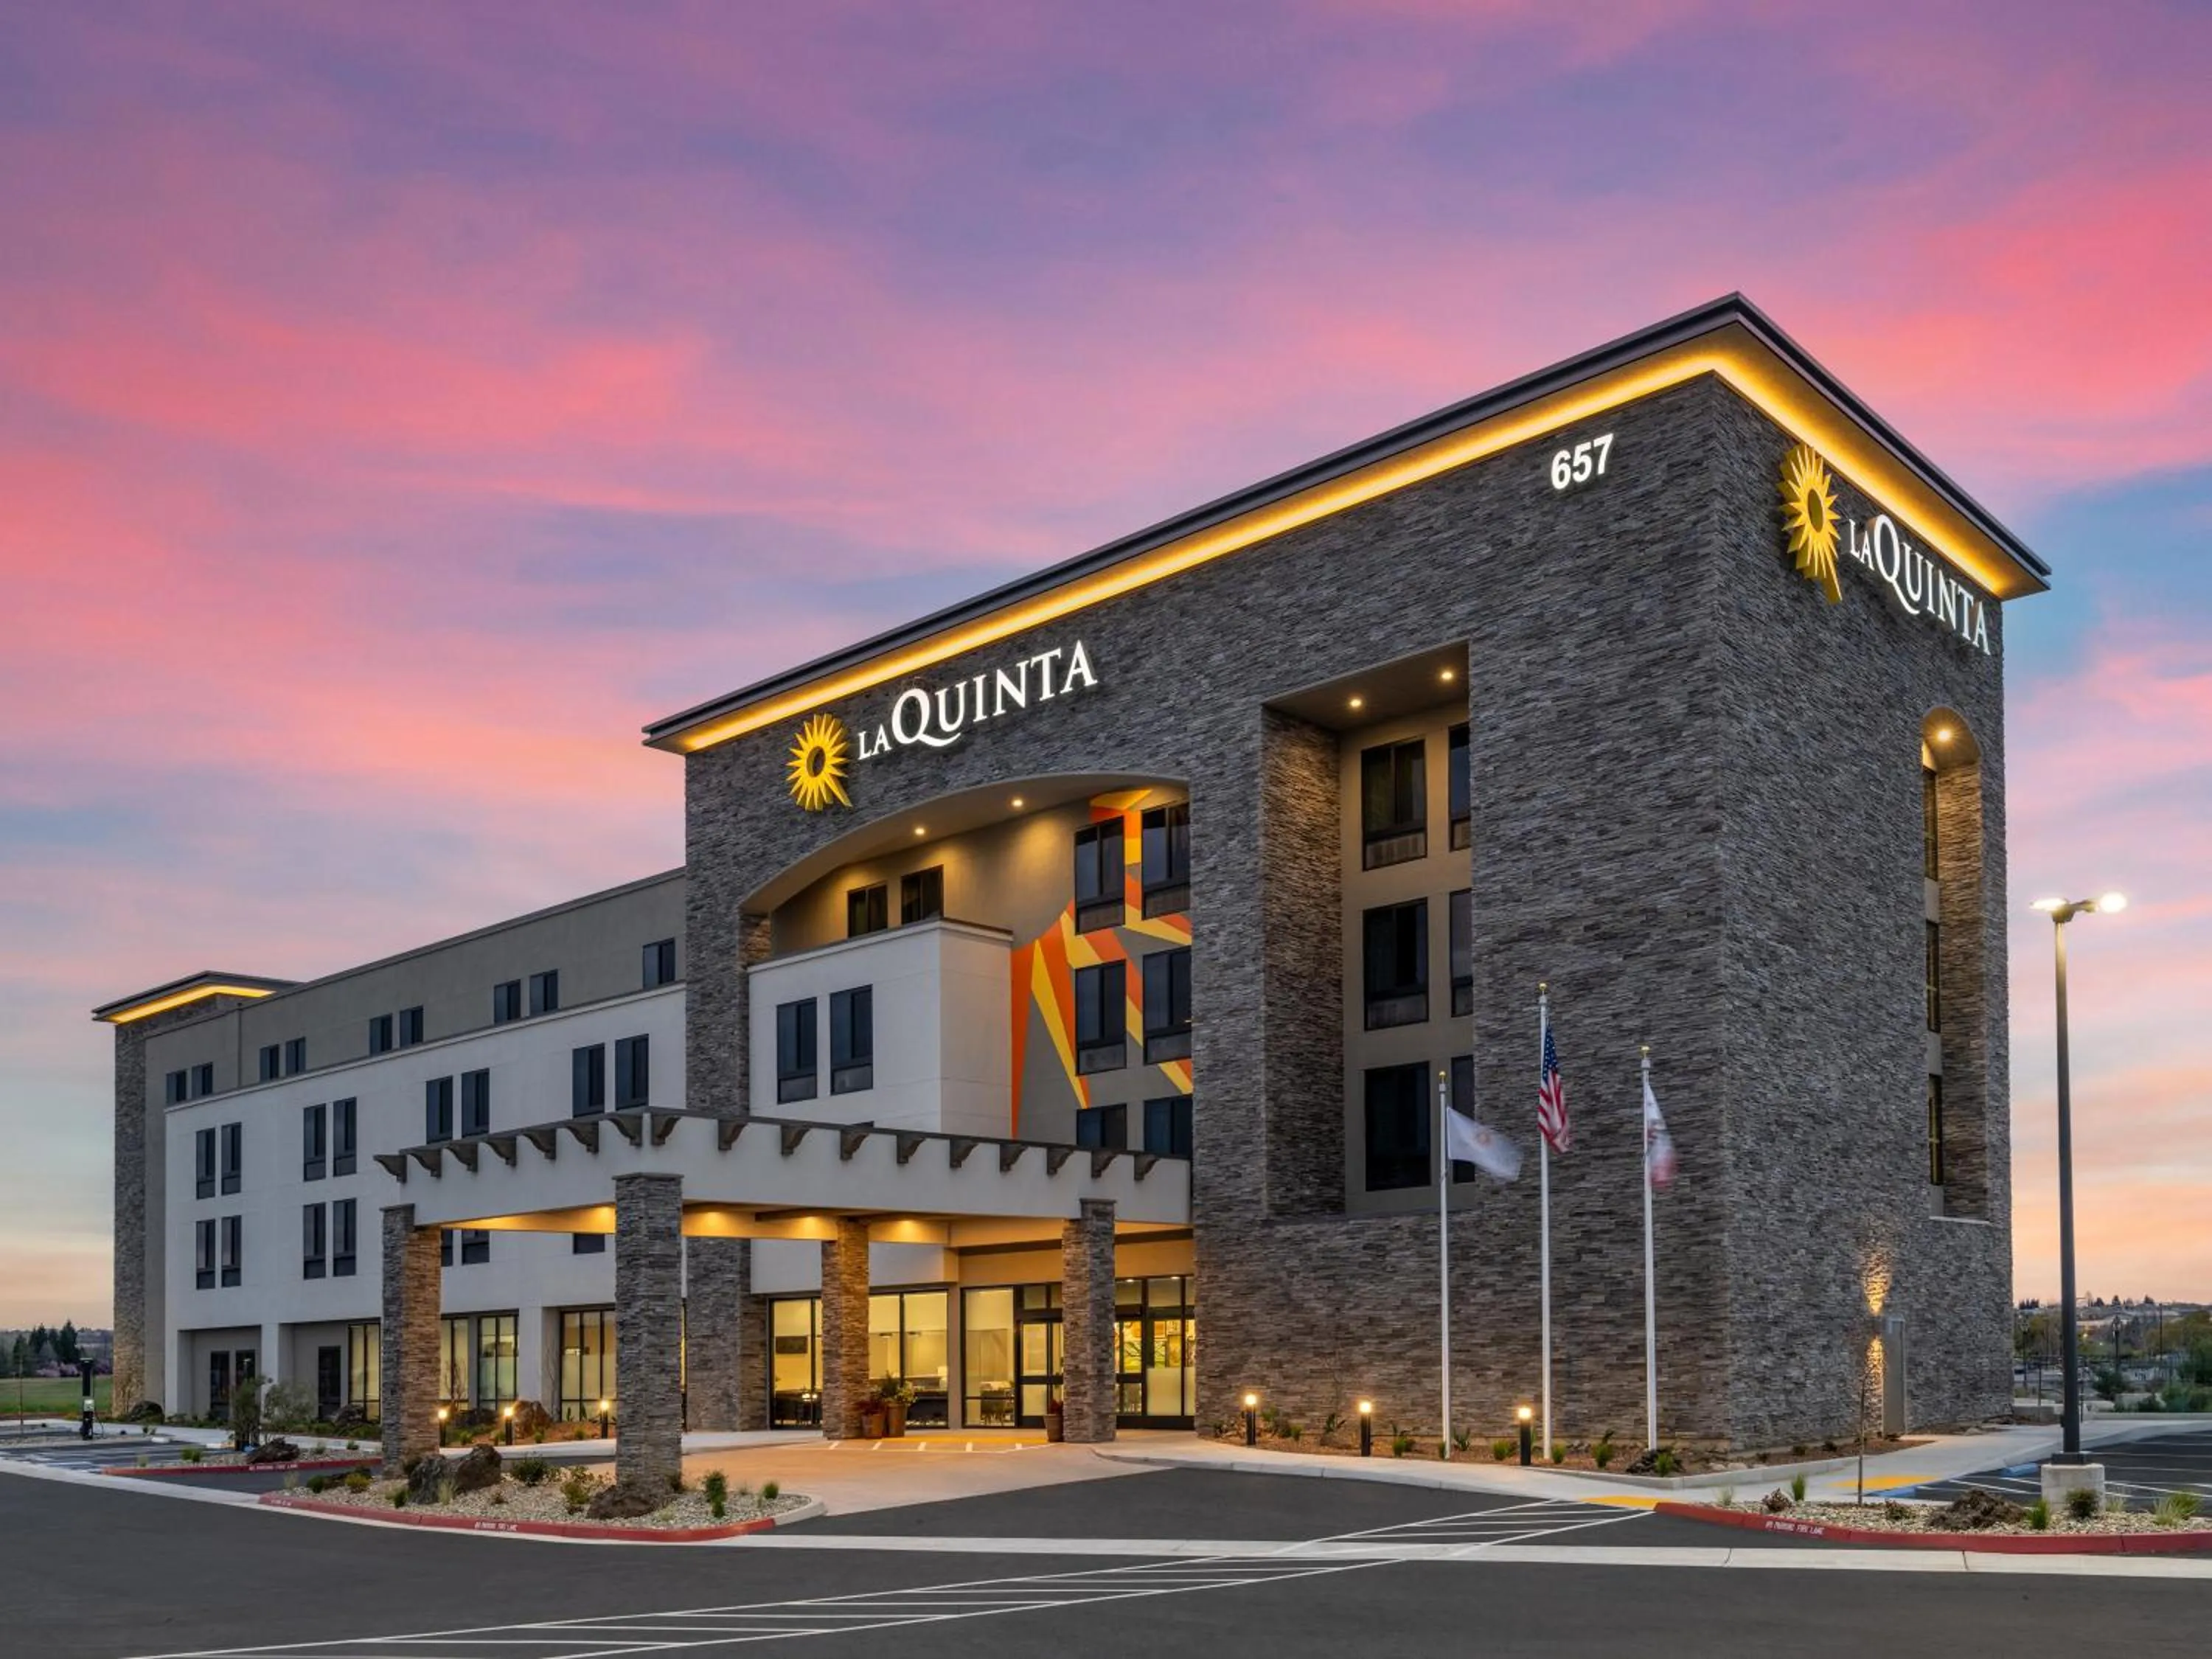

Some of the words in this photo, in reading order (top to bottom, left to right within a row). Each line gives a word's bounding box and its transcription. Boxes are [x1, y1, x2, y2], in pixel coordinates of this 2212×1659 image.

[1551, 434, 1614, 490] 657
[1848, 518, 1874, 570] LA
[1874, 514, 1991, 655] QUINTA
[858, 723, 891, 760] LA
[891, 639, 1098, 747] QUINTA
